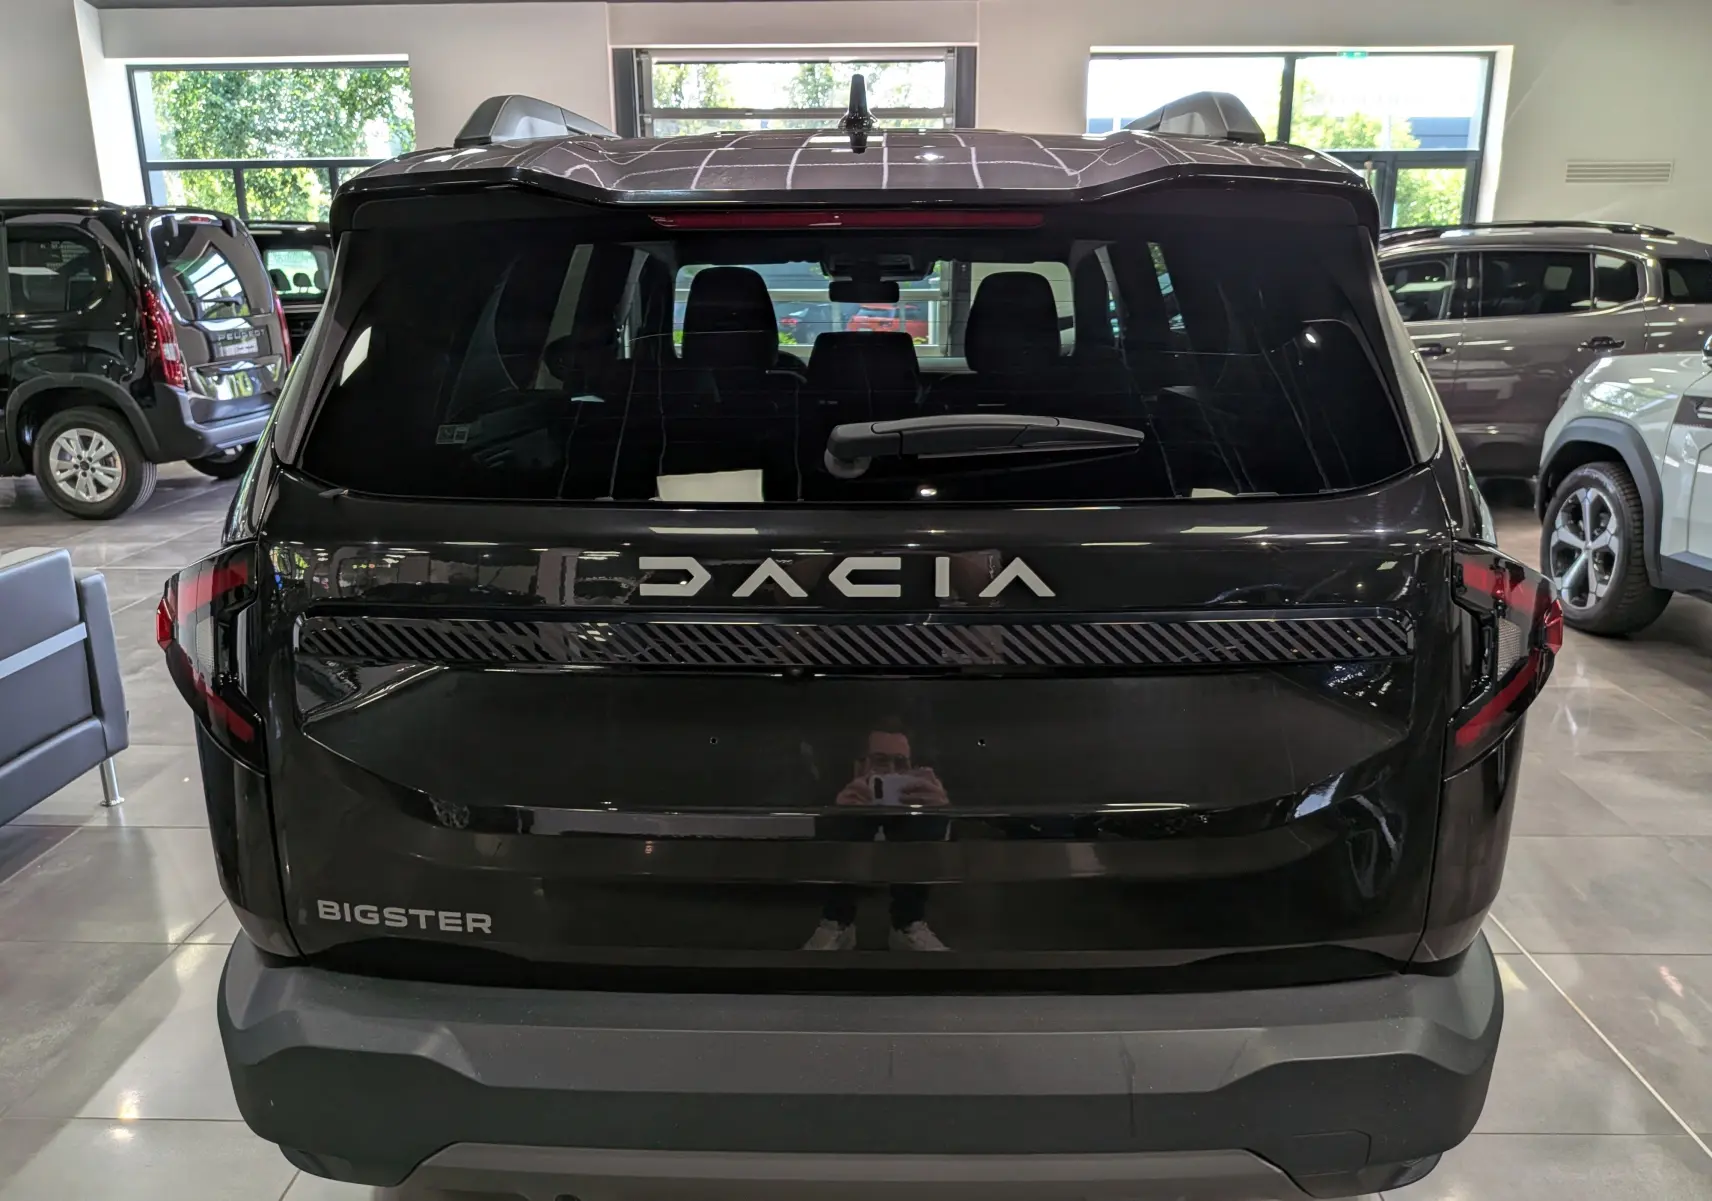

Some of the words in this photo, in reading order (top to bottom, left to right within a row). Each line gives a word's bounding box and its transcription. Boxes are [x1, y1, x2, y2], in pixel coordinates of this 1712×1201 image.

[218, 328, 265, 341] PEUGEOT
[638, 556, 1056, 598] DACIA
[317, 899, 492, 934] BIGSTER
